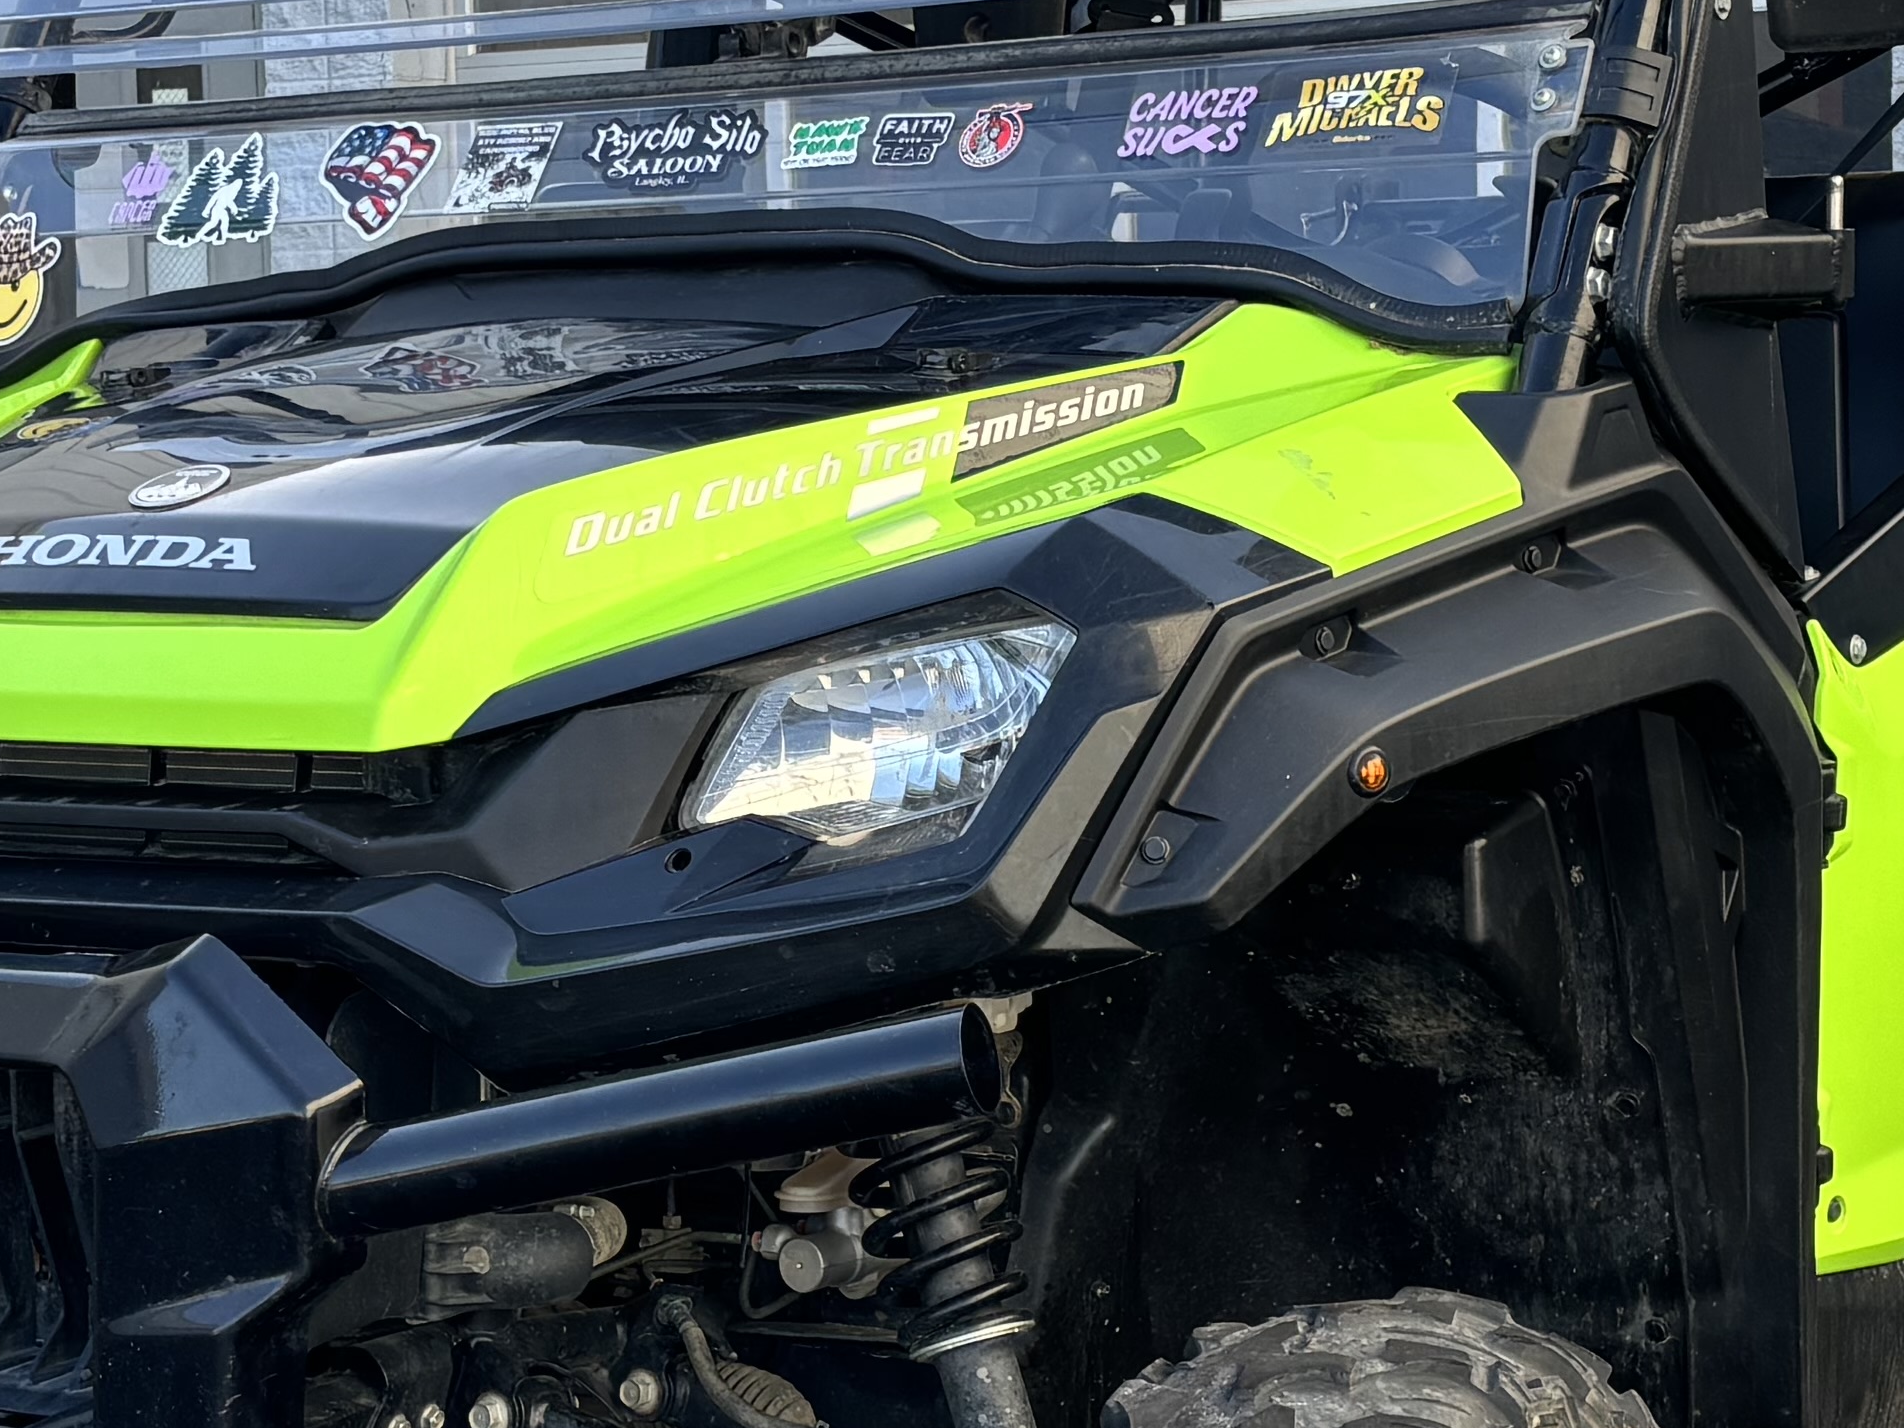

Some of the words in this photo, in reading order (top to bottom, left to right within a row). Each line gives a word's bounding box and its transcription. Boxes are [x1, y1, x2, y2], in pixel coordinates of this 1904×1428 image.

[1129, 86, 1258, 122] CANCER
[588, 113, 696, 162] Psycho
[703, 115, 762, 154] Silo
[882, 119, 947, 135] FAITH
[879, 147, 931, 161] FEAR
[564, 489, 680, 557] Dual
[695, 452, 842, 521] Clutch
[854, 380, 1145, 478] Transmission
